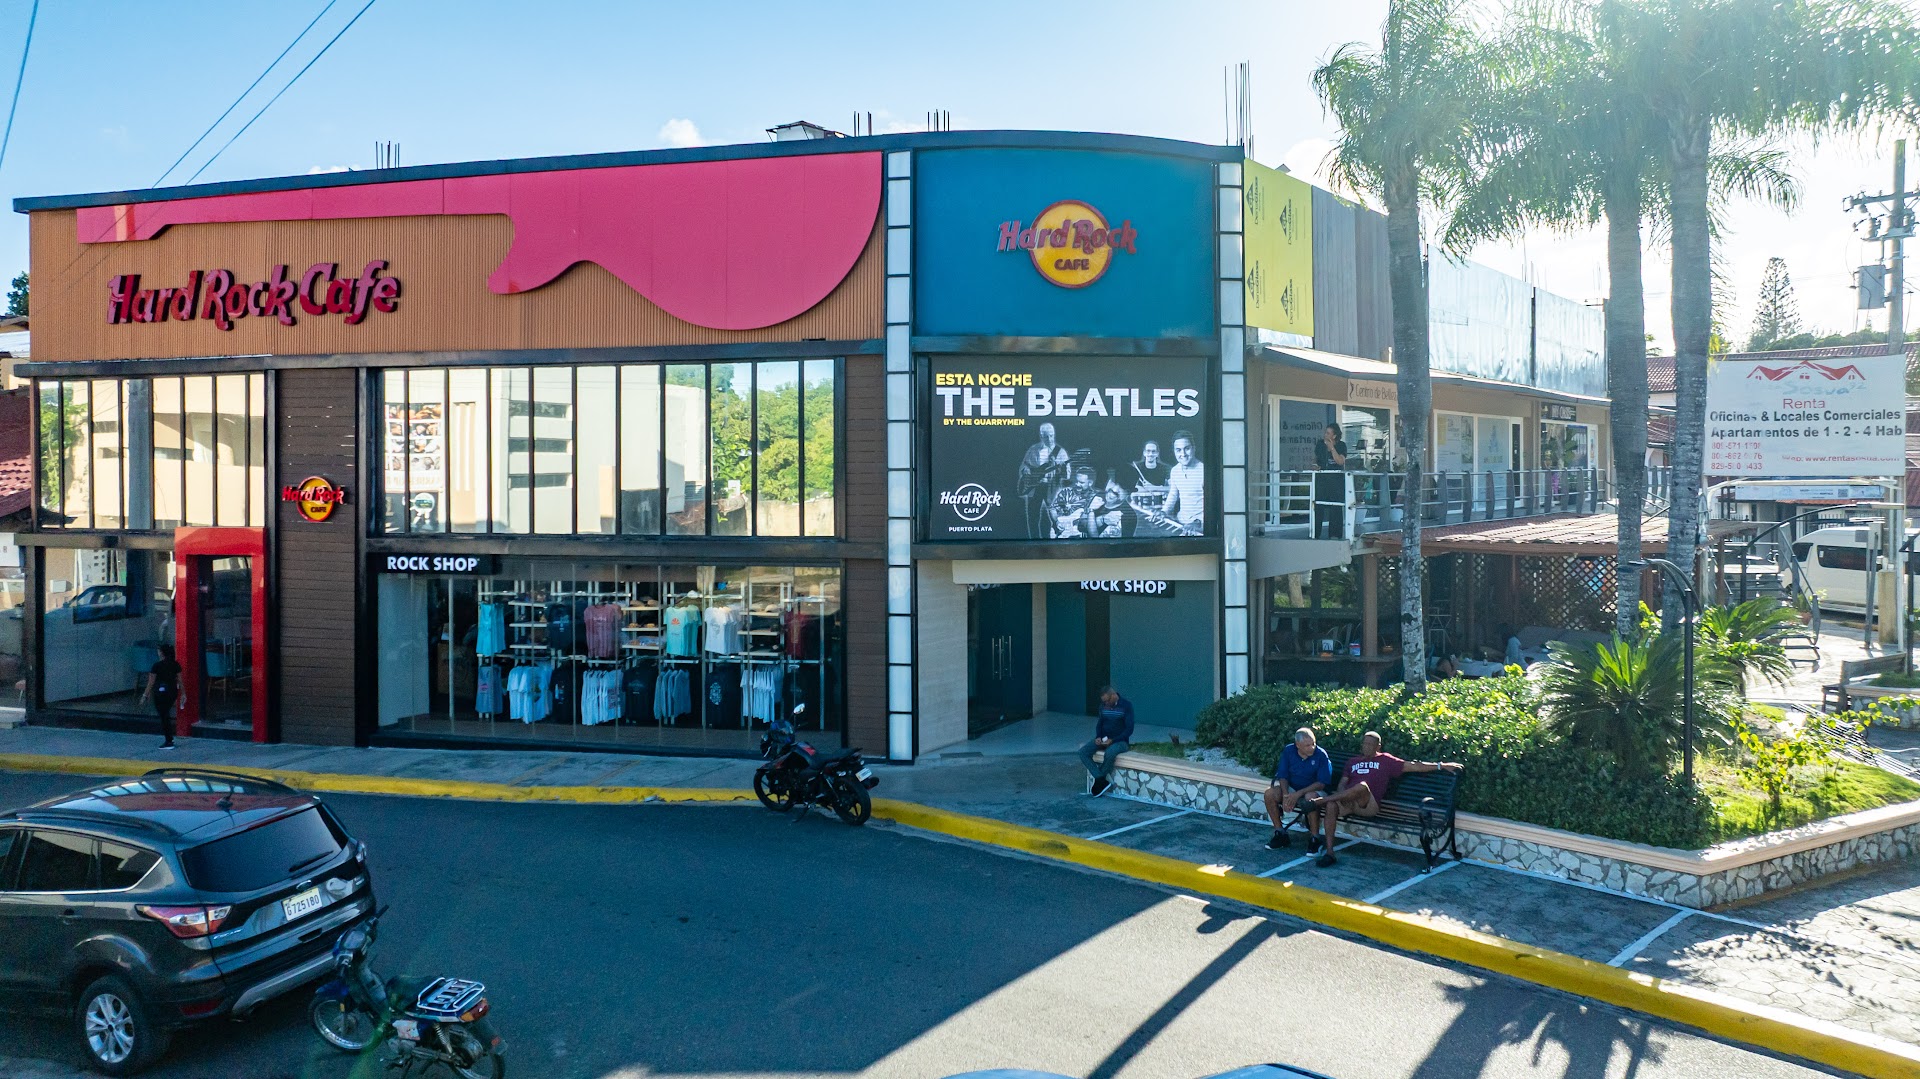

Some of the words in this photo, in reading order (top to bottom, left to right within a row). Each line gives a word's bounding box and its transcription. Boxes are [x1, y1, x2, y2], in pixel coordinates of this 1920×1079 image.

[997, 219, 1071, 252] Hard
[1072, 219, 1138, 255] Rock
[1054, 258, 1090, 271] CAFE
[107, 270, 204, 325] Hard
[201, 265, 298, 331] Rock
[300, 260, 401, 325] Cafe
[935, 373, 975, 386] ESTA
[978, 374, 1033, 386] NOCHE
[1381, 387, 1397, 401] Bellez
[936, 387, 1016, 417] THE
[1027, 388, 1200, 417] BEATLES
[1783, 398, 1826, 409] Renta
[1761, 410, 1769, 421] &
[1774, 410, 1819, 421] Locales
[1824, 409, 1901, 421] Comerciales
[1803, 426, 1819, 437] de
[1823, 426, 1830, 437] 1
[1843, 426, 1851, 437] 2
[1863, 426, 1871, 437] 4
[1875, 425, 1903, 436] Hab
[282, 485, 315, 502] Hard
[315, 486, 345, 505] Rock
[940, 491, 972, 505] Hard
[972, 491, 1001, 507] Rock
[387, 556, 430, 571] ROCK
[433, 556, 478, 572] SHOP
[1080, 580, 1121, 592] ROCK
[1123, 580, 1167, 594] SHOP
[286, 894, 321, 916] G725180
